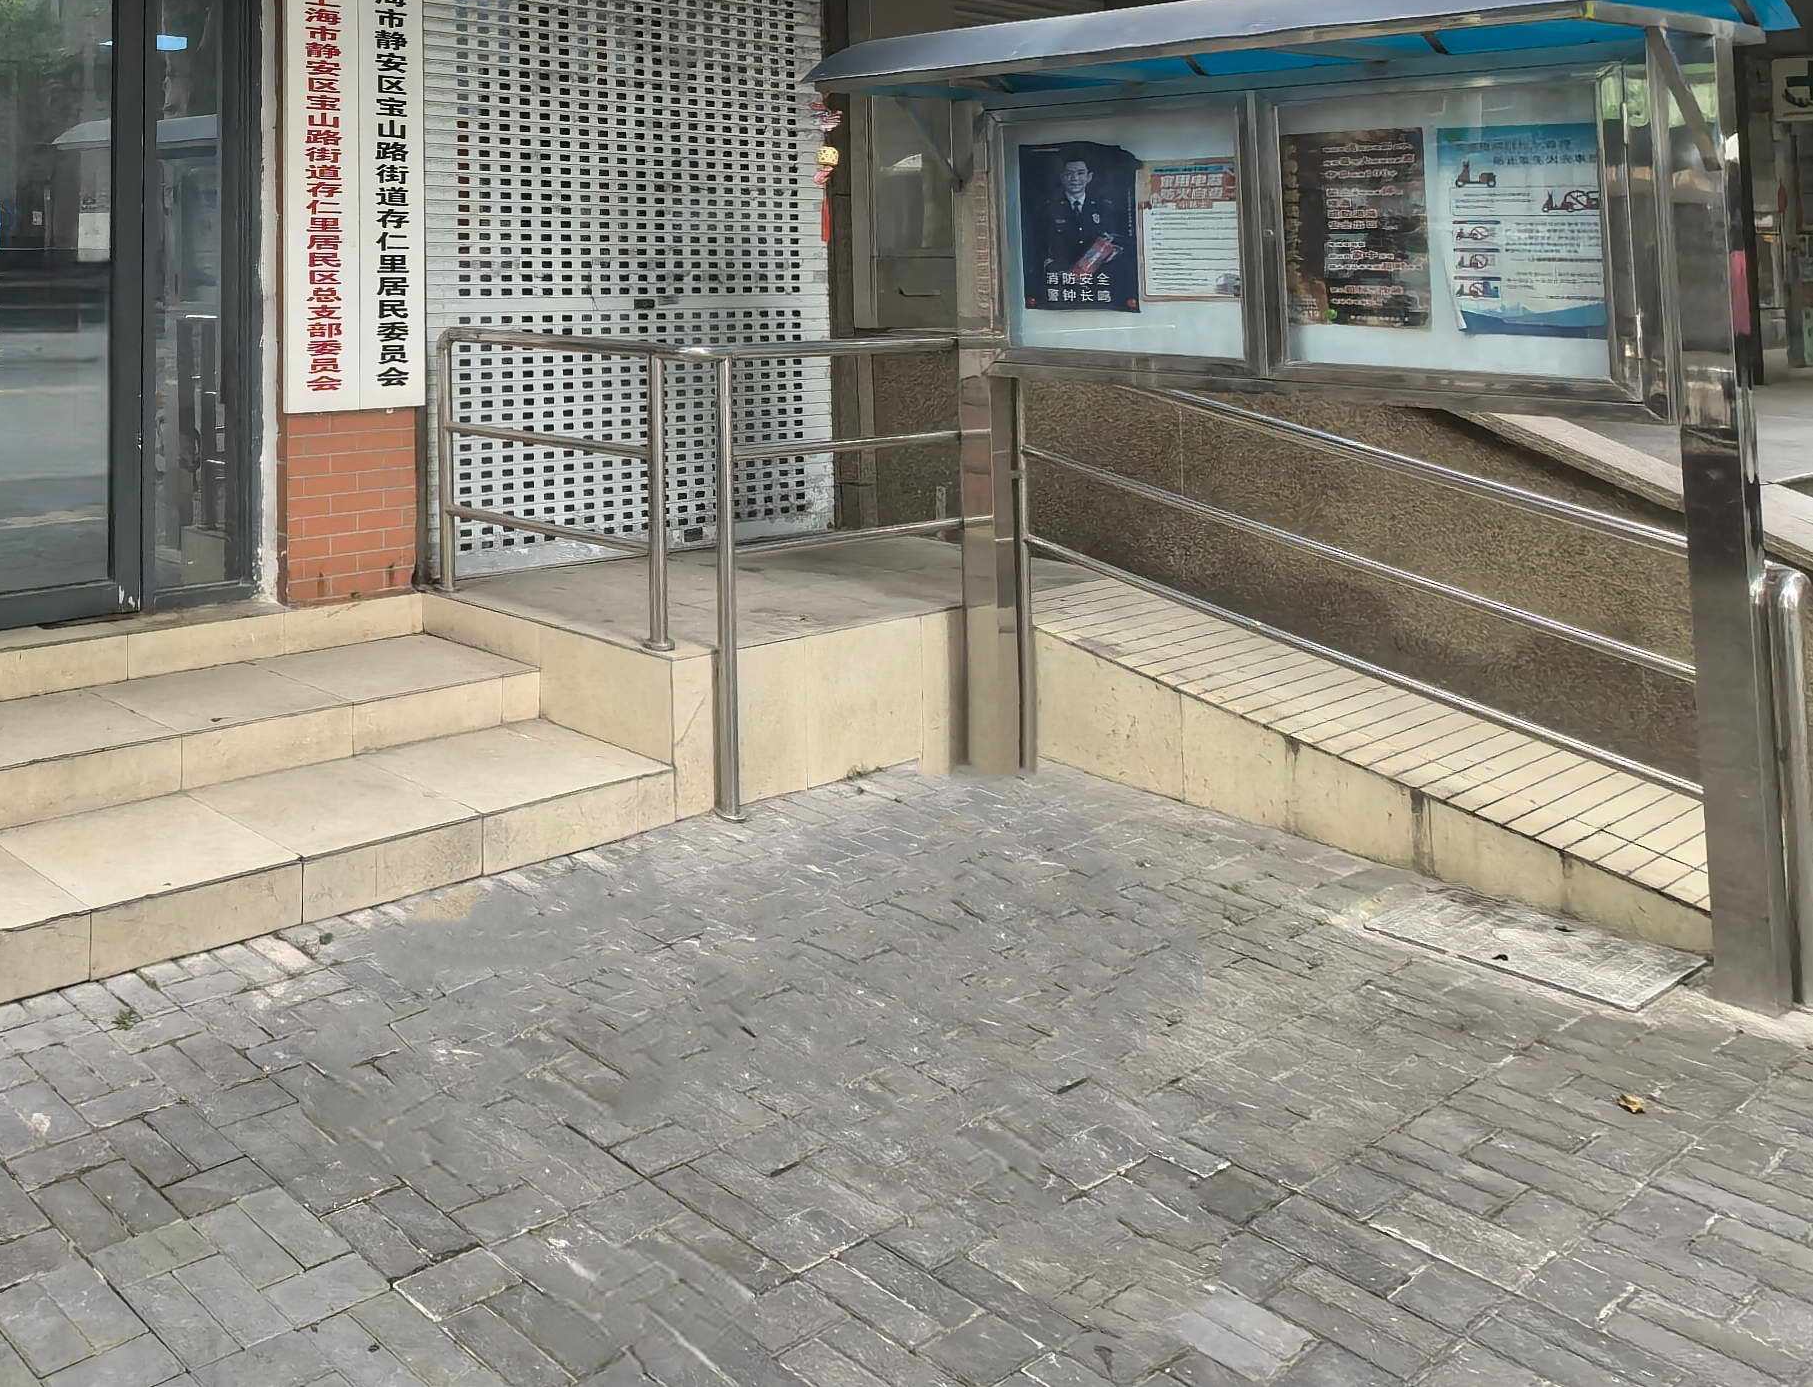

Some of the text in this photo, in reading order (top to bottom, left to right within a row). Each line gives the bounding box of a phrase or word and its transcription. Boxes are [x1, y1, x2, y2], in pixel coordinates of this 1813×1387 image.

[1046, 272, 1111, 286] 消防安全
[1046, 288, 1112, 303] 警钟长鸣
